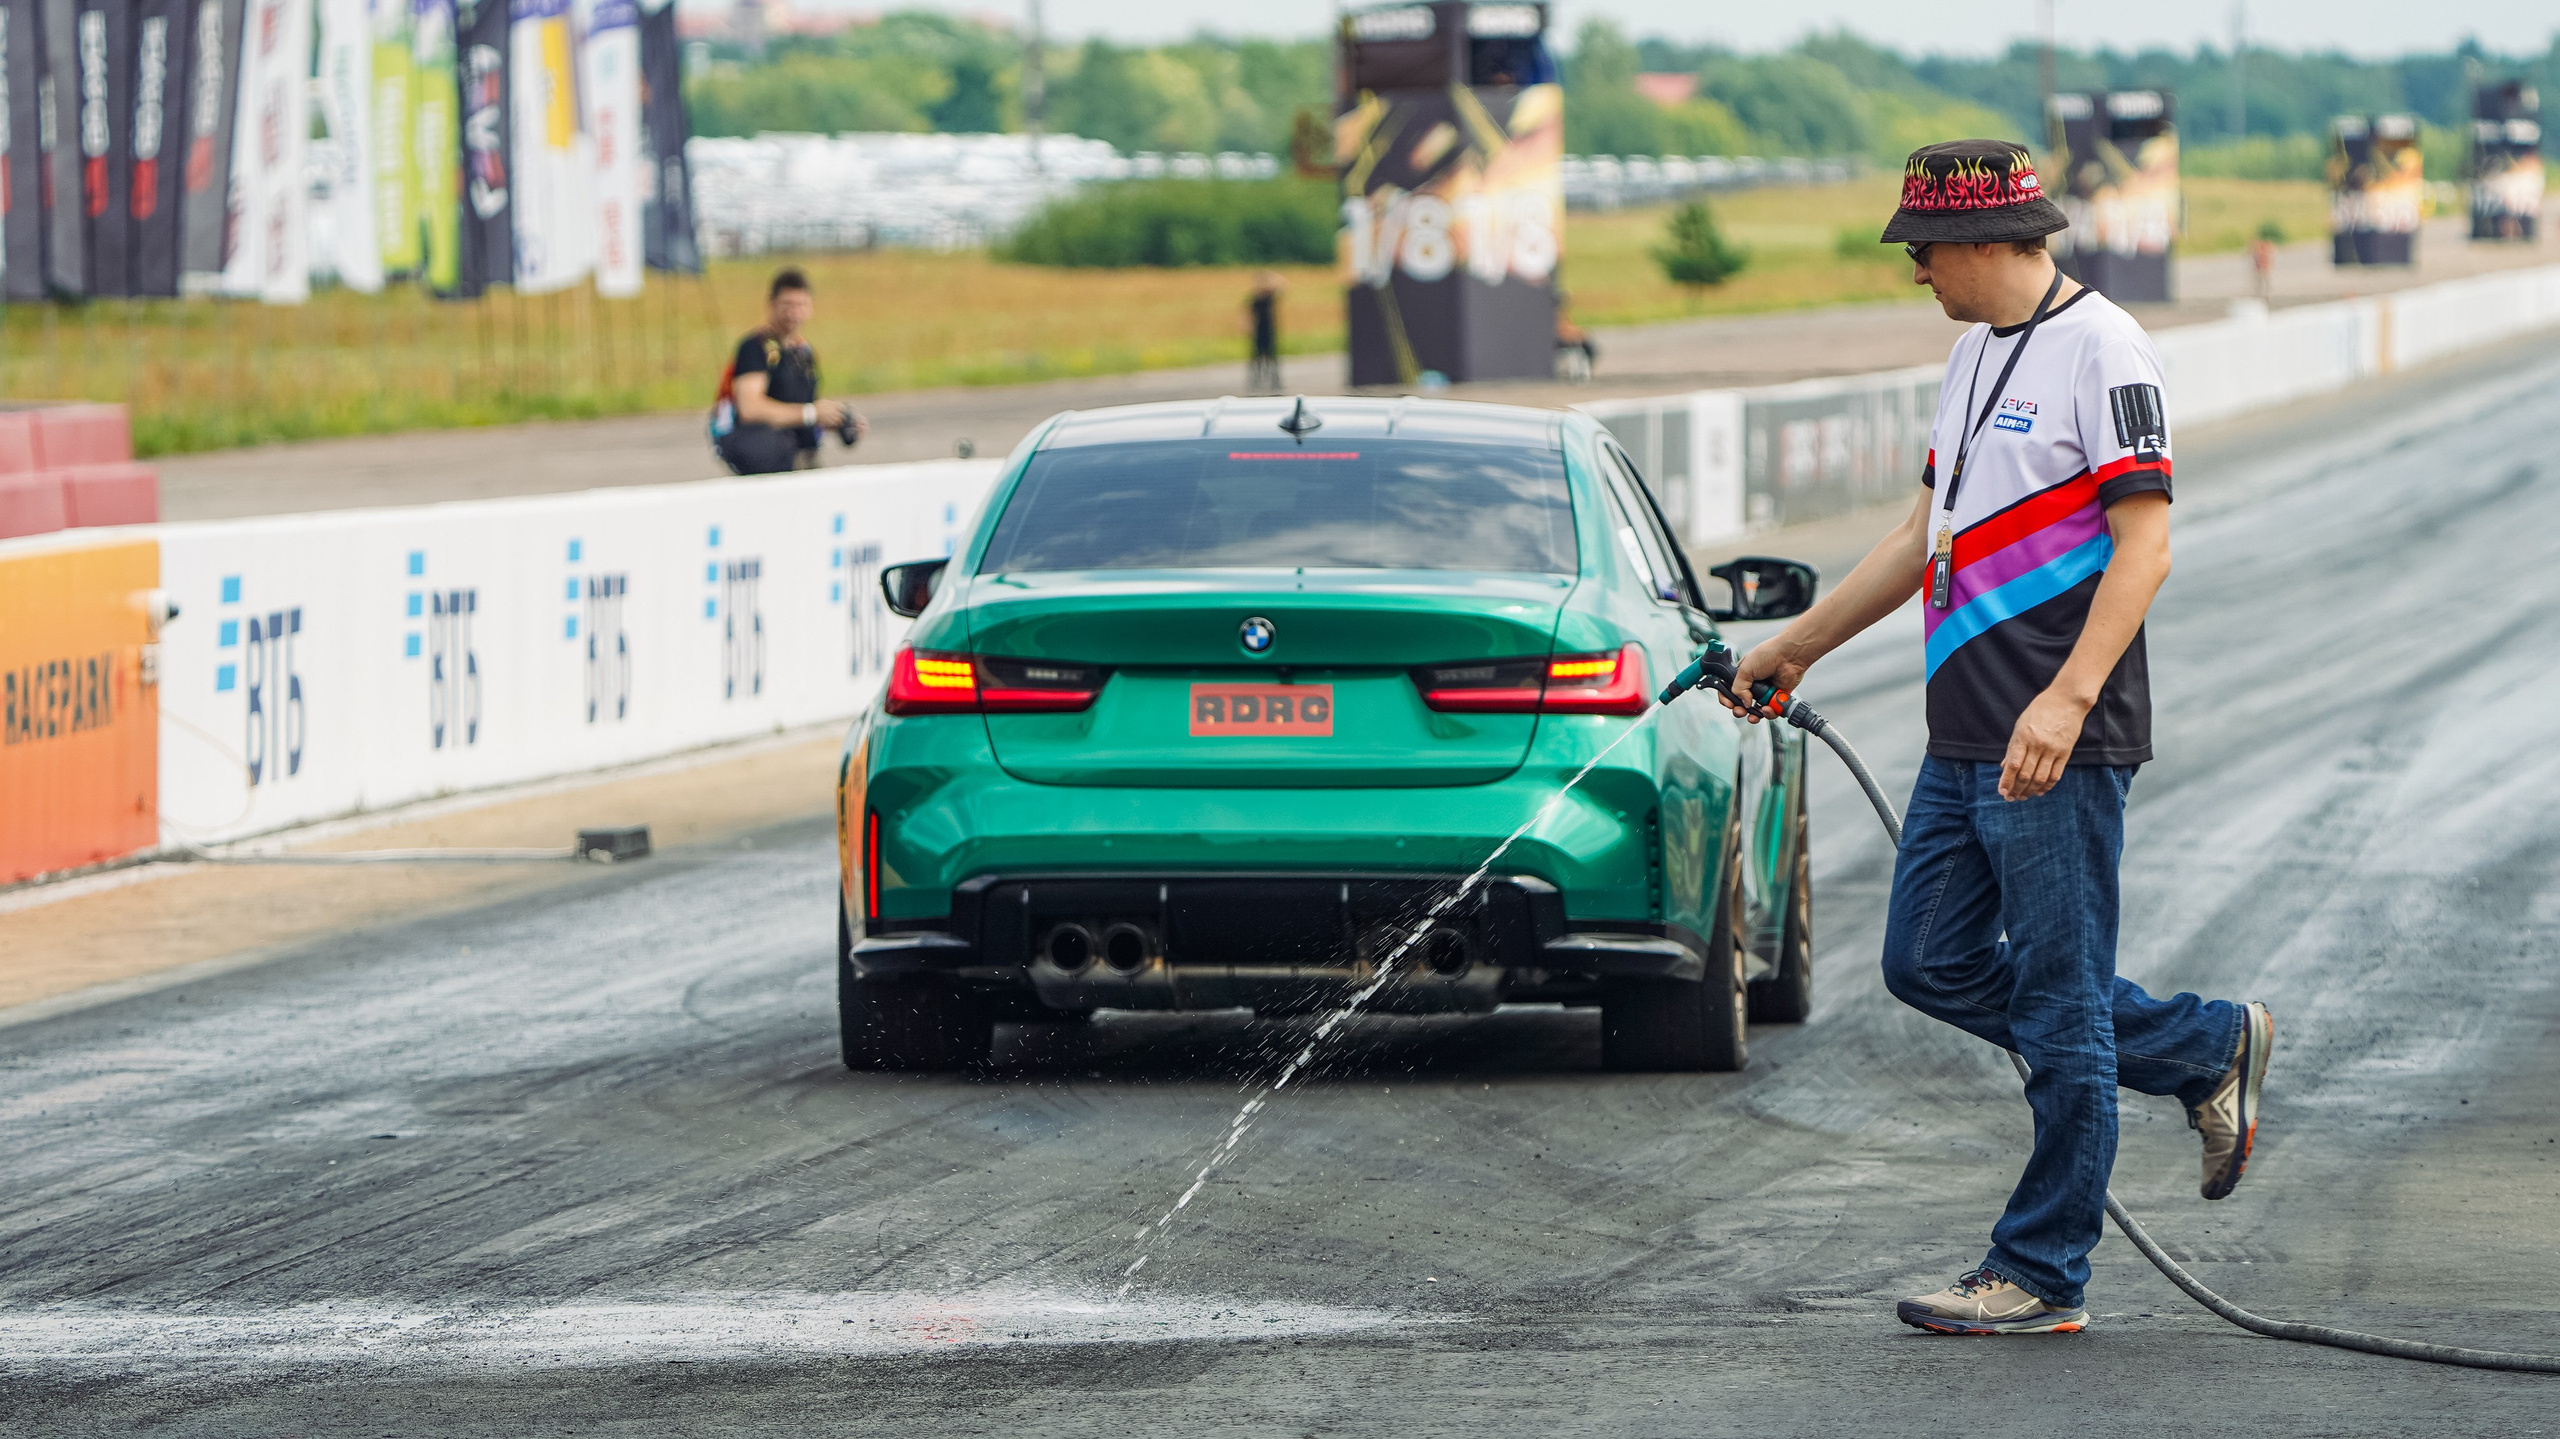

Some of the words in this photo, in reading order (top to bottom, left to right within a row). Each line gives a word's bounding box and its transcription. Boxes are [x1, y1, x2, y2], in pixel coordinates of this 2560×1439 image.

[2001, 397, 2037, 415] LEVEL
[4, 650, 113, 745] RACEPARK
[247, 607, 304, 787] ВТБ
[1197, 696, 1329, 723] RDRC
